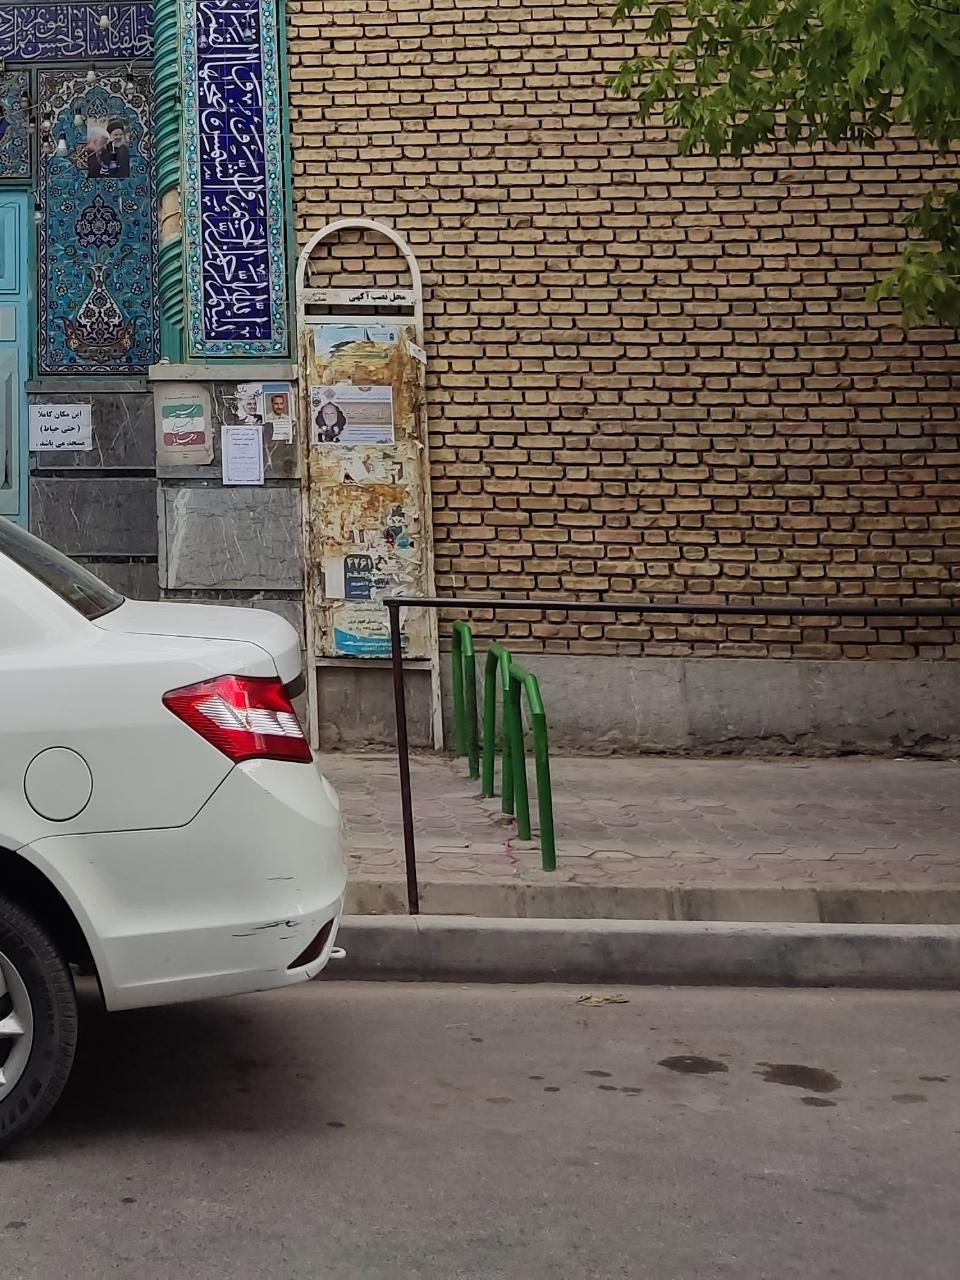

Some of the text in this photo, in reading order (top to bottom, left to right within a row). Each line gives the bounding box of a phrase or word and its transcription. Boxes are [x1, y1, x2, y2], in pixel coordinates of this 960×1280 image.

[371, 291, 388, 303] نصب
[54, 410, 69, 419] مکان
[72, 410, 81, 419] این
